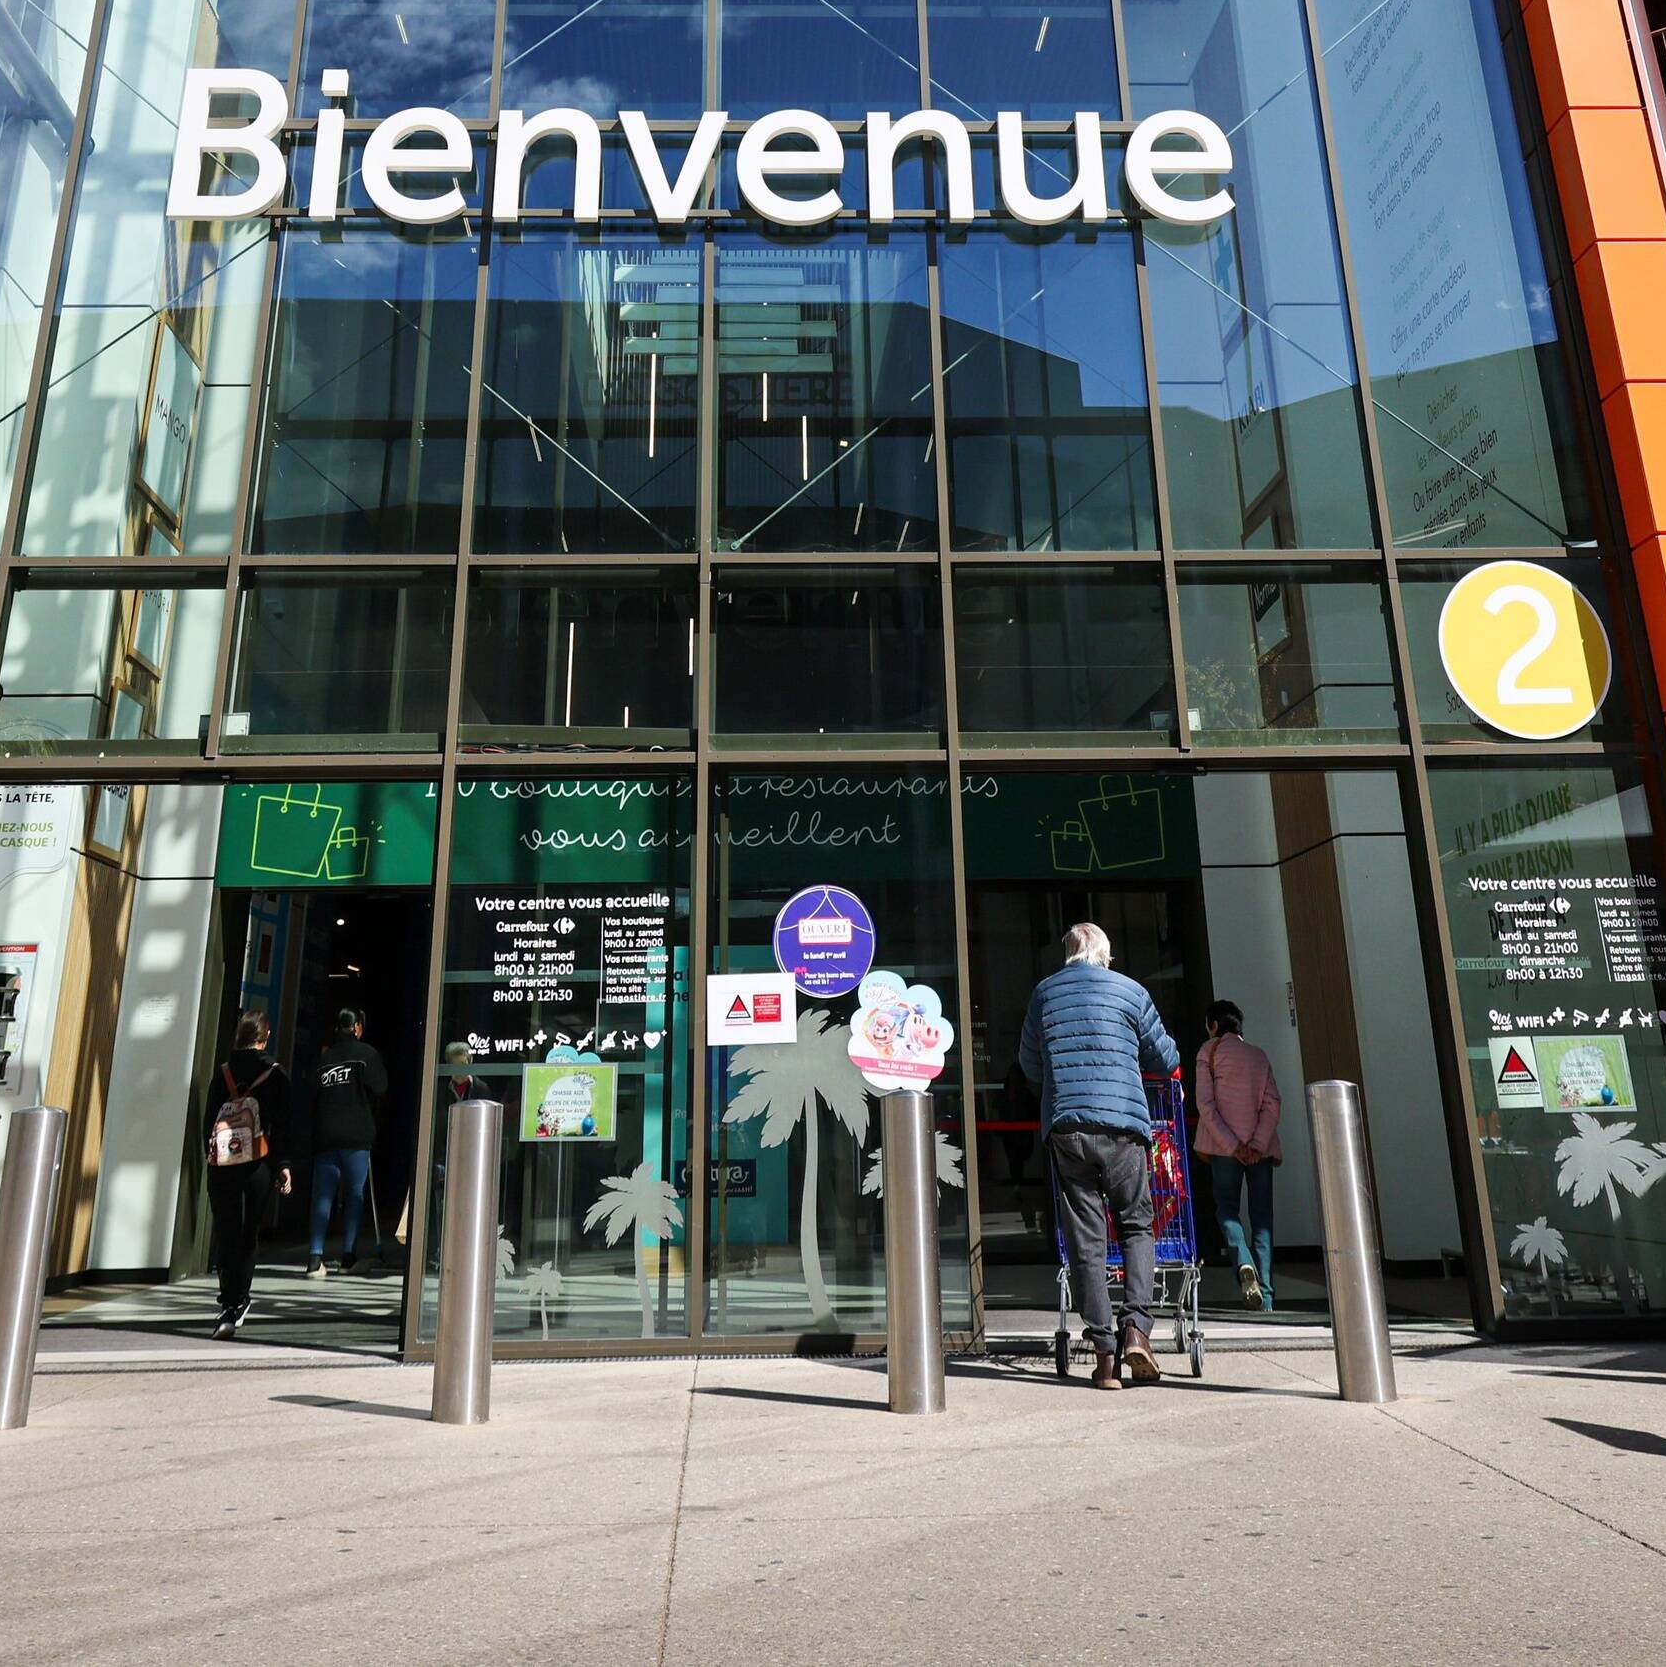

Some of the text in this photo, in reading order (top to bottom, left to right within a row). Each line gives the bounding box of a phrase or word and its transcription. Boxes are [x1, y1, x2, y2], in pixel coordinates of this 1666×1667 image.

[166, 68, 1235, 226] Bienvenue
[1441, 260, 1467, 298] cadeau
[1443, 290, 1471, 328] tromper
[1238, 381, 1266, 434] KIABI
[155, 394, 187, 444] MANGO
[1479, 430, 1497, 454] bien
[1449, 492, 1467, 518] dans
[1467, 474, 1479, 501] les
[1459, 514, 1487, 544] enfants
[1483, 584, 1573, 704] 2
[6, 794, 21, 803] LA
[1492, 800, 1524, 842] PLUS
[0, 838, 48, 847] CASQUE
[520, 828, 627, 852] vous
[1469, 875, 1656, 891] Votre centre vous accueille
[476, 894, 670, 911] Votre centre vous accueille
[1495, 902, 1545, 912] Carrefour
[1598, 898, 1612, 906] Vos
[496, 921, 549, 932] Carrefour
[605, 917, 664, 927] Vos boutiques
[1515, 918, 1557, 927] Horaires
[1602, 919, 1623, 928] 9h00
[638, 929, 663, 937] samedi
[802, 925, 846, 934] OUVERT
[1498, 931, 1522, 941] lundi
[1544, 931, 1577, 940] samedi
[1606, 934, 1621, 943] Vos
[514, 938, 557, 948] Horaires
[605, 939, 626, 948] 9h00
[635, 939, 663, 947] 20h00
[1502, 942, 1578, 955] 8h00 21h00
[494, 951, 575, 961] lundi au samedi
[605, 955, 668, 963] Vos restaurants
[1519, 956, 1565, 966] dimanche
[494, 964, 573, 976] 8h00 à 21h00
[1506, 968, 1583, 980] 8h00 à 12h30
[510, 978, 557, 987] dimanche
[620, 976, 650, 984] horaires
[629, 985, 642, 993] site
[493, 990, 573, 1002] 8h00 à 12h30
[1516, 1017, 1544, 1028] WIFI
[495, 1040, 523, 1051] WIFI
